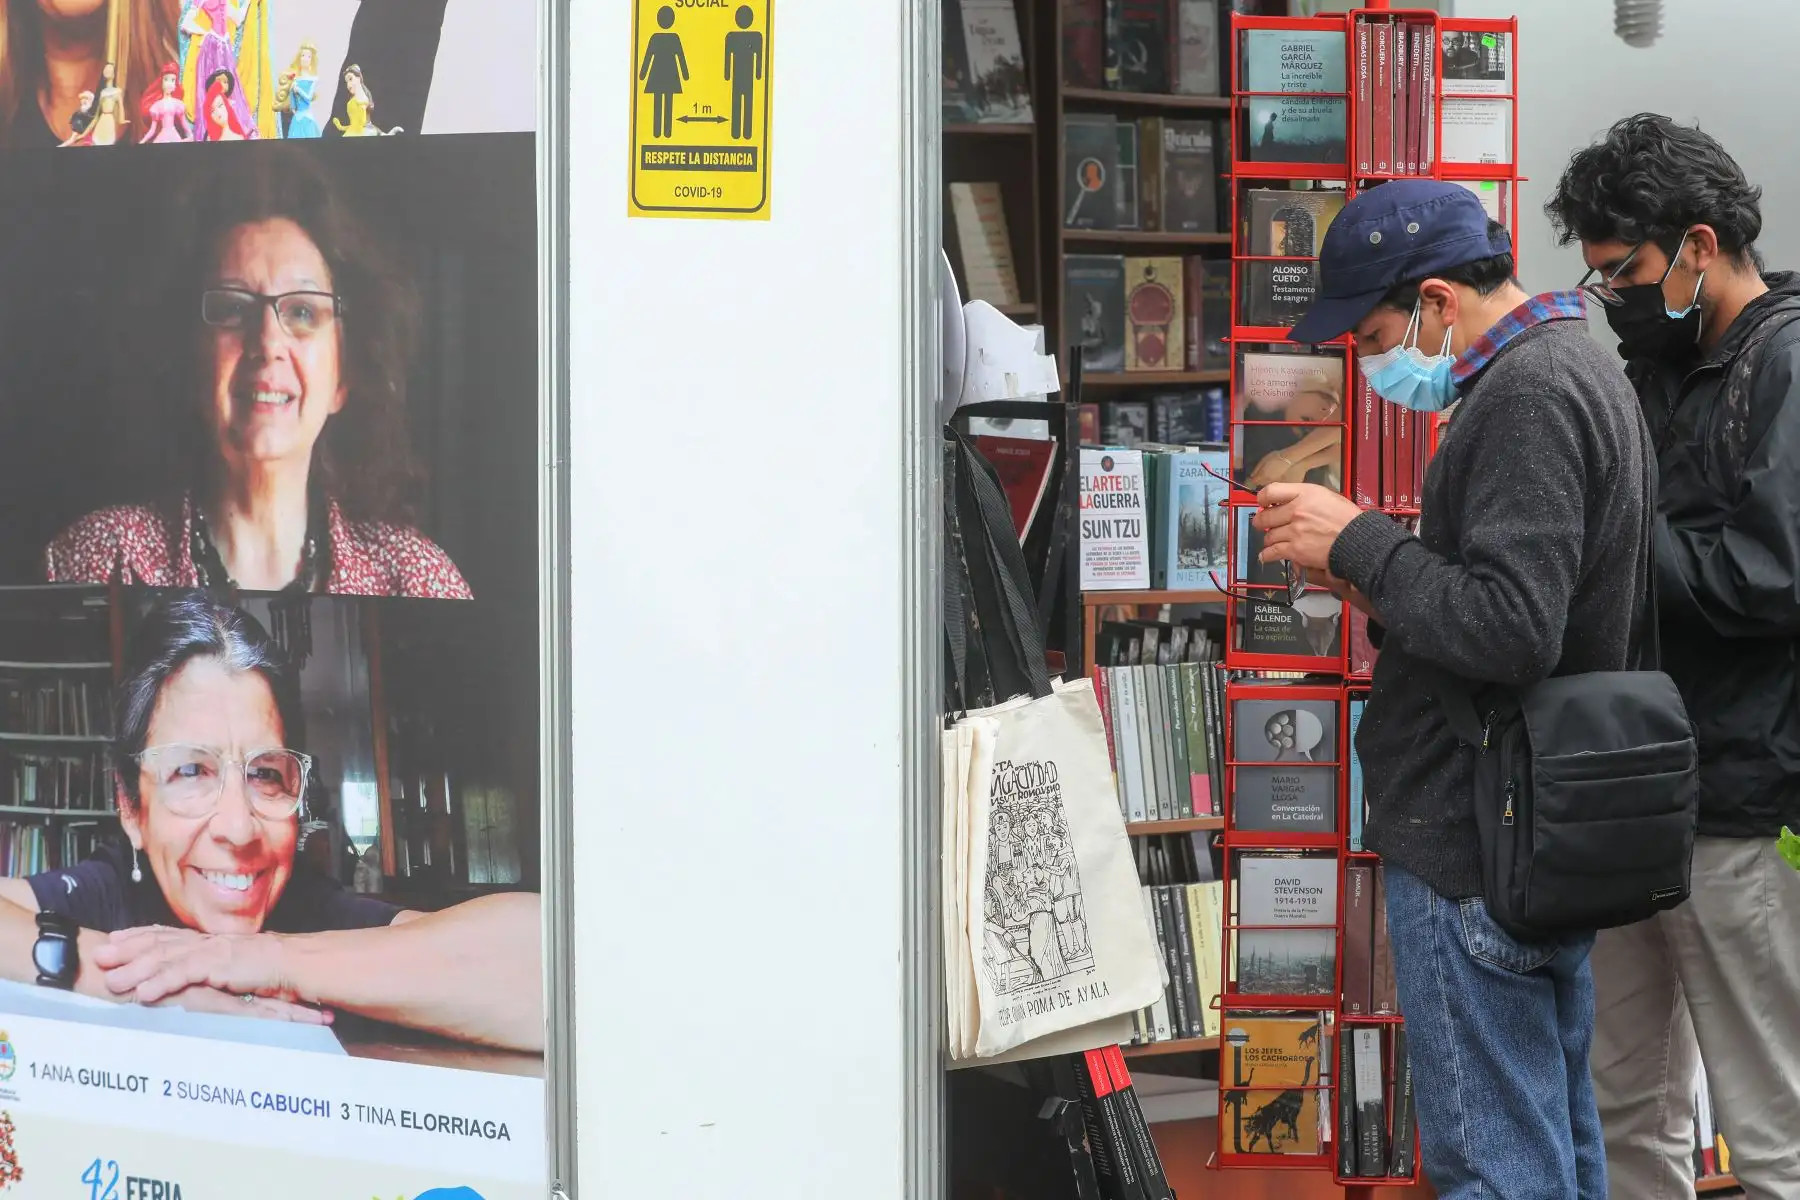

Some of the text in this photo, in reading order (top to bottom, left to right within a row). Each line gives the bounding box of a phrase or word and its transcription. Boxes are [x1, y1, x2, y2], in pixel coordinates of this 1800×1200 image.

[675, 0, 729, 8] SOCIAL
[1281, 62, 1323, 70] MÁRQUEZ
[693, 103, 712, 114] 1 m
[645, 151, 753, 166] RESPETE LA DISTANCIA
[674, 186, 722, 198] COVID-19
[1273, 285, 1315, 293] Testamento
[1180, 467, 1229, 478] ZARATSTR
[1082, 519, 1140, 539] SUN TZU
[1254, 606, 1282, 614] ISABEL
[1272, 776, 1300, 784] MARIO
[1272, 804, 1320, 812] Conversación
[1027, 996, 1055, 1017] POMA
[1058, 990, 1073, 1009] DE
[1078, 981, 1110, 1004] AYALA
[29, 1062, 511, 1142] 1 ANA GUILLOT 2 SUSANA CABUCHI 3 TINA ELORRIAGA
[81, 1158, 182, 1200] 42 FERIA
